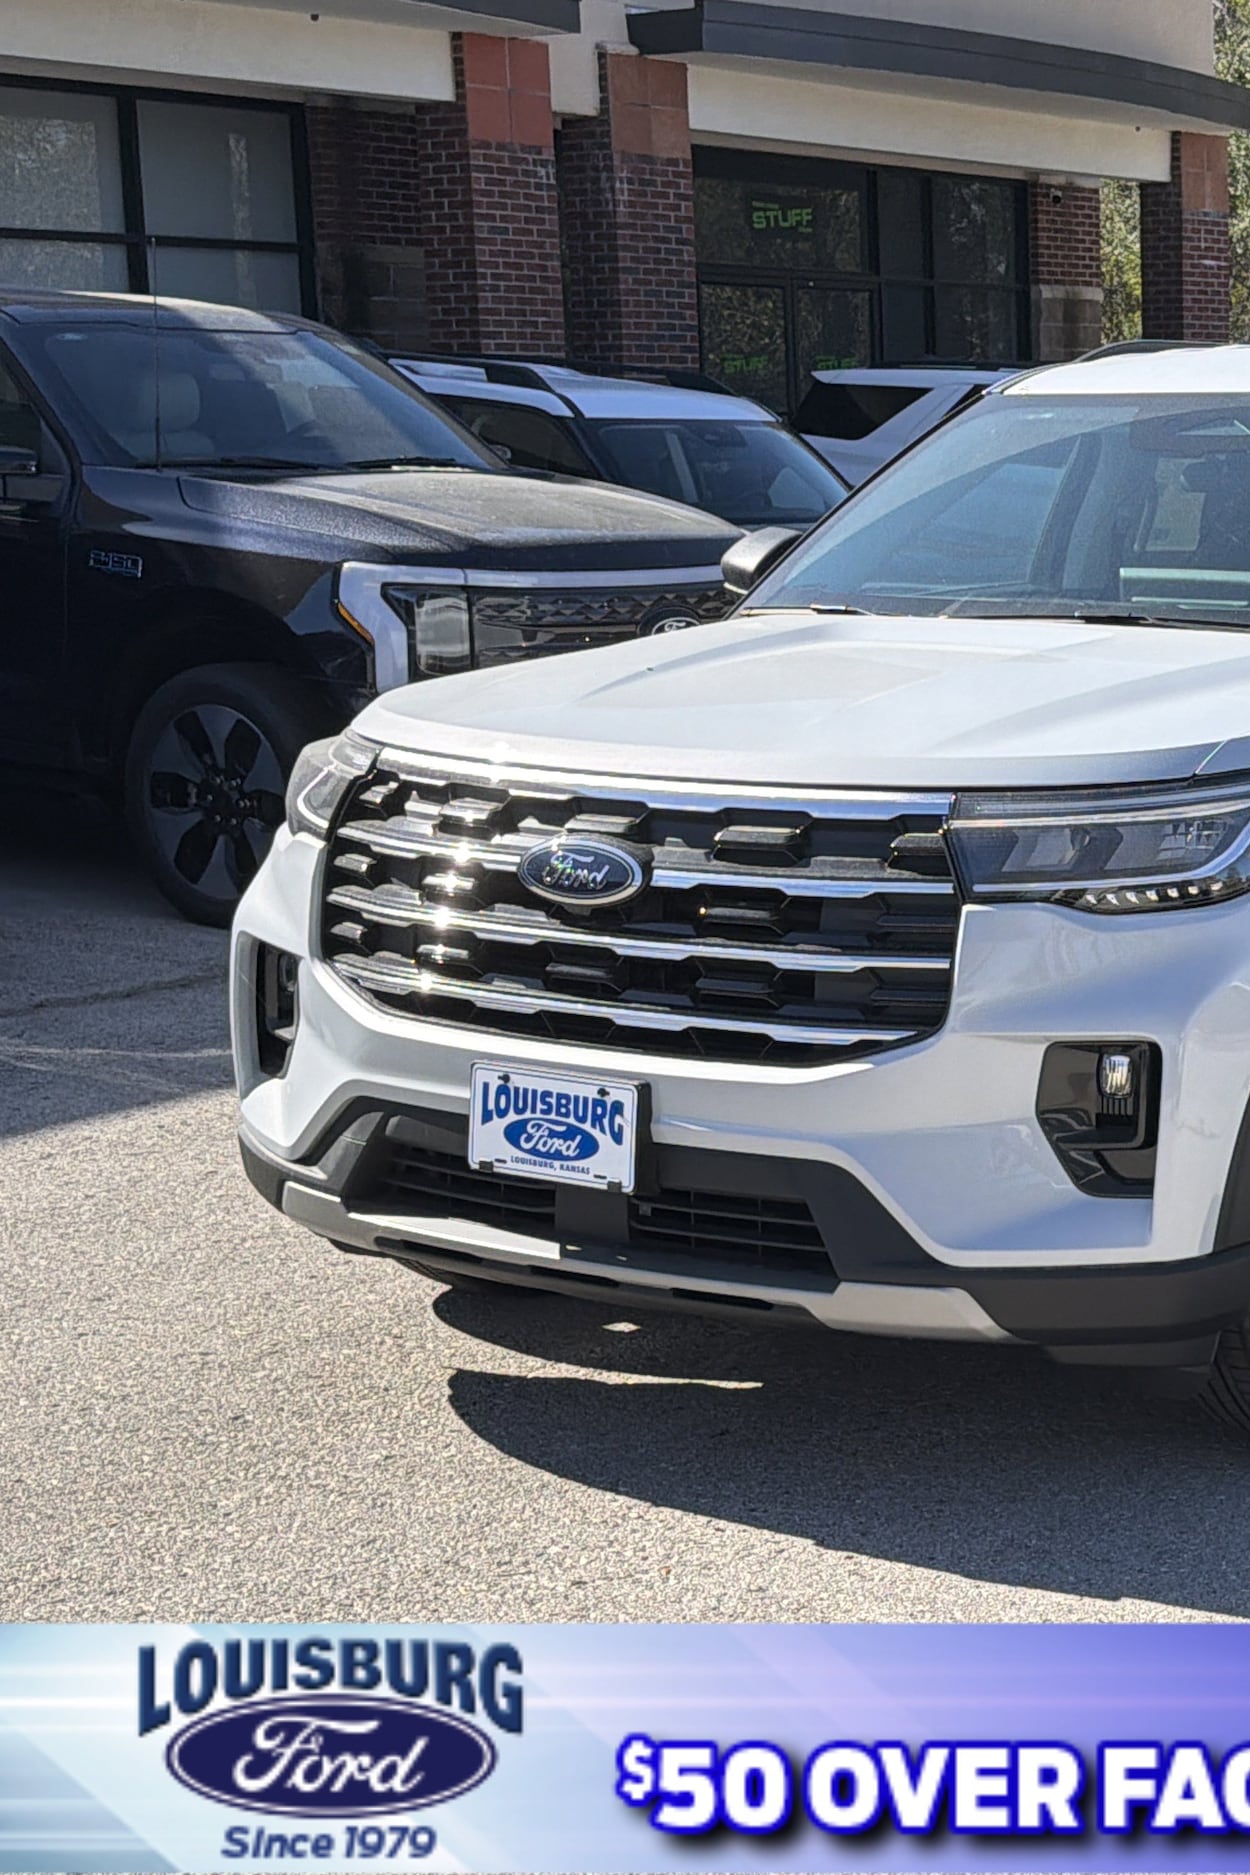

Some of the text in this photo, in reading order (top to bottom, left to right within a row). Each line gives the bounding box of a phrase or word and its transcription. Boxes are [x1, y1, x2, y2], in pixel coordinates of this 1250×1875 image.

[752, 208, 813, 230] STUFF
[541, 850, 610, 891] Ford
[481, 1081, 625, 1146] LOUISBURG
[519, 1119, 583, 1158] Ford
[510, 1154, 591, 1176] LOUISBURG, KANSAS
